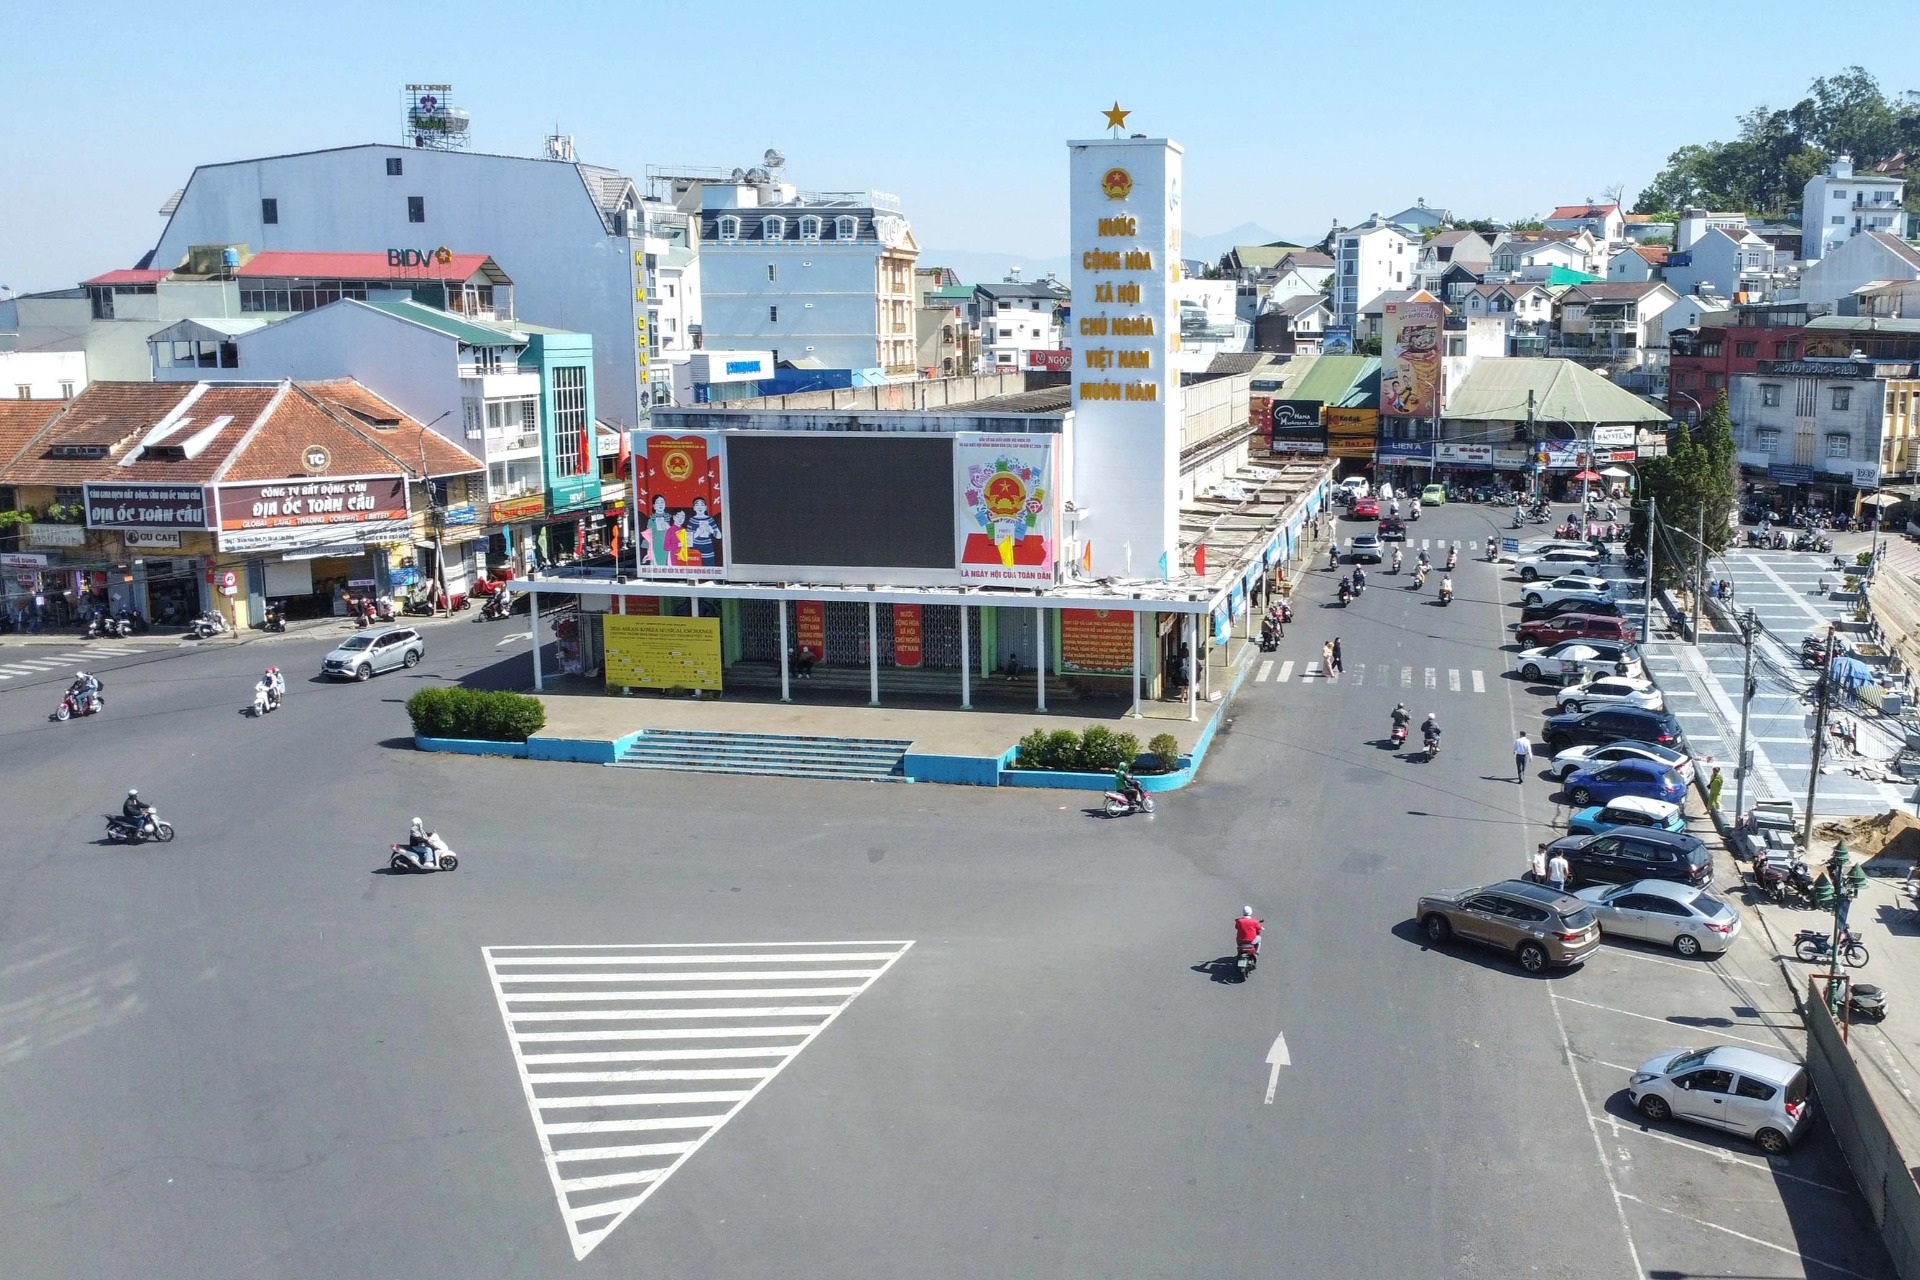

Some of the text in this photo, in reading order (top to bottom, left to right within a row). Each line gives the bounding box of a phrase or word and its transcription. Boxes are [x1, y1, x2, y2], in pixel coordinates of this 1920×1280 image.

[1098, 213, 1136, 236] NƯỚC
[388, 248, 433, 268] BIDV
[1083, 248, 1152, 273] CỘNG HÒA
[635, 251, 646, 302] KIM
[1095, 281, 1140, 306] XÃ HỘI
[1080, 311, 1154, 336] CHỦ NGHĨA
[638, 316, 648, 385] OANH
[1086, 347, 1150, 372] VIỆT NAM
[1080, 379, 1157, 402] MUÔN NĂM
[308, 453, 325, 465] TC
[261, 486, 285, 498] CÔNG
[287, 486, 300, 497] TY
[301, 483, 319, 495] BẤT
[321, 483, 346, 495] ĐỘNG
[92, 503, 202, 523] ĐỊA ỐC TOÀN CẦU
[252, 493, 375, 519] ĐỊA ỐC TOÀN CẦU
[242, 520, 268, 528] GLOBAL
[296, 516, 325, 525] TRADING
[364, 512, 389, 521] LIMITED
[140, 533, 178, 542] GU CAFE
[961, 569, 969, 577] LÀ
[971, 569, 988, 578] NGÀY
[990, 570, 1001, 579] HỘI
[1018, 570, 1035, 579] TOÀN
[1037, 570, 1051, 580] DÂN
